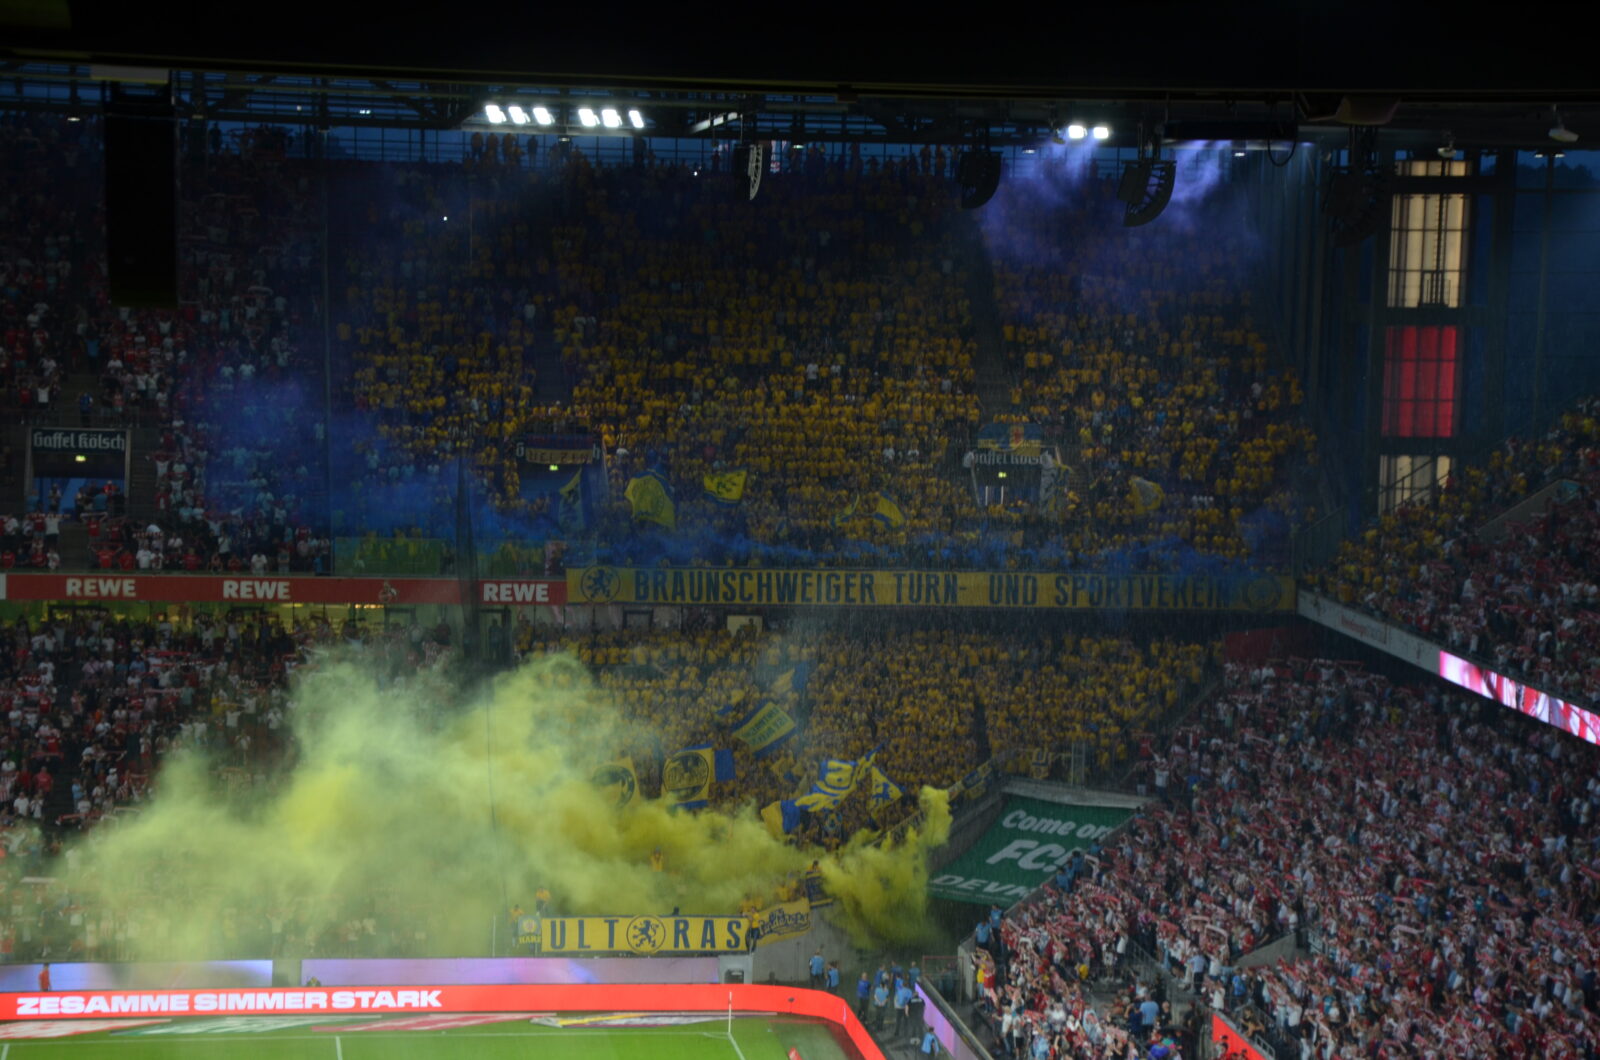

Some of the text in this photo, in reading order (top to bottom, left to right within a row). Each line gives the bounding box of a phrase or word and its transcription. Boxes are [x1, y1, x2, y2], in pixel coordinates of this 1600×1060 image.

[33, 431, 125, 451] Gaffel Kölsch
[66, 578, 136, 598] REWE
[223, 580, 291, 600] REWE
[483, 583, 549, 602] REWE
[634, 570, 1231, 609] BRAUNSCHWEIGER TURN- UND SPORTVEREIN
[1002, 809, 1076, 836] Come
[16, 990, 442, 1015] ZESAMME SIMMER STARK
